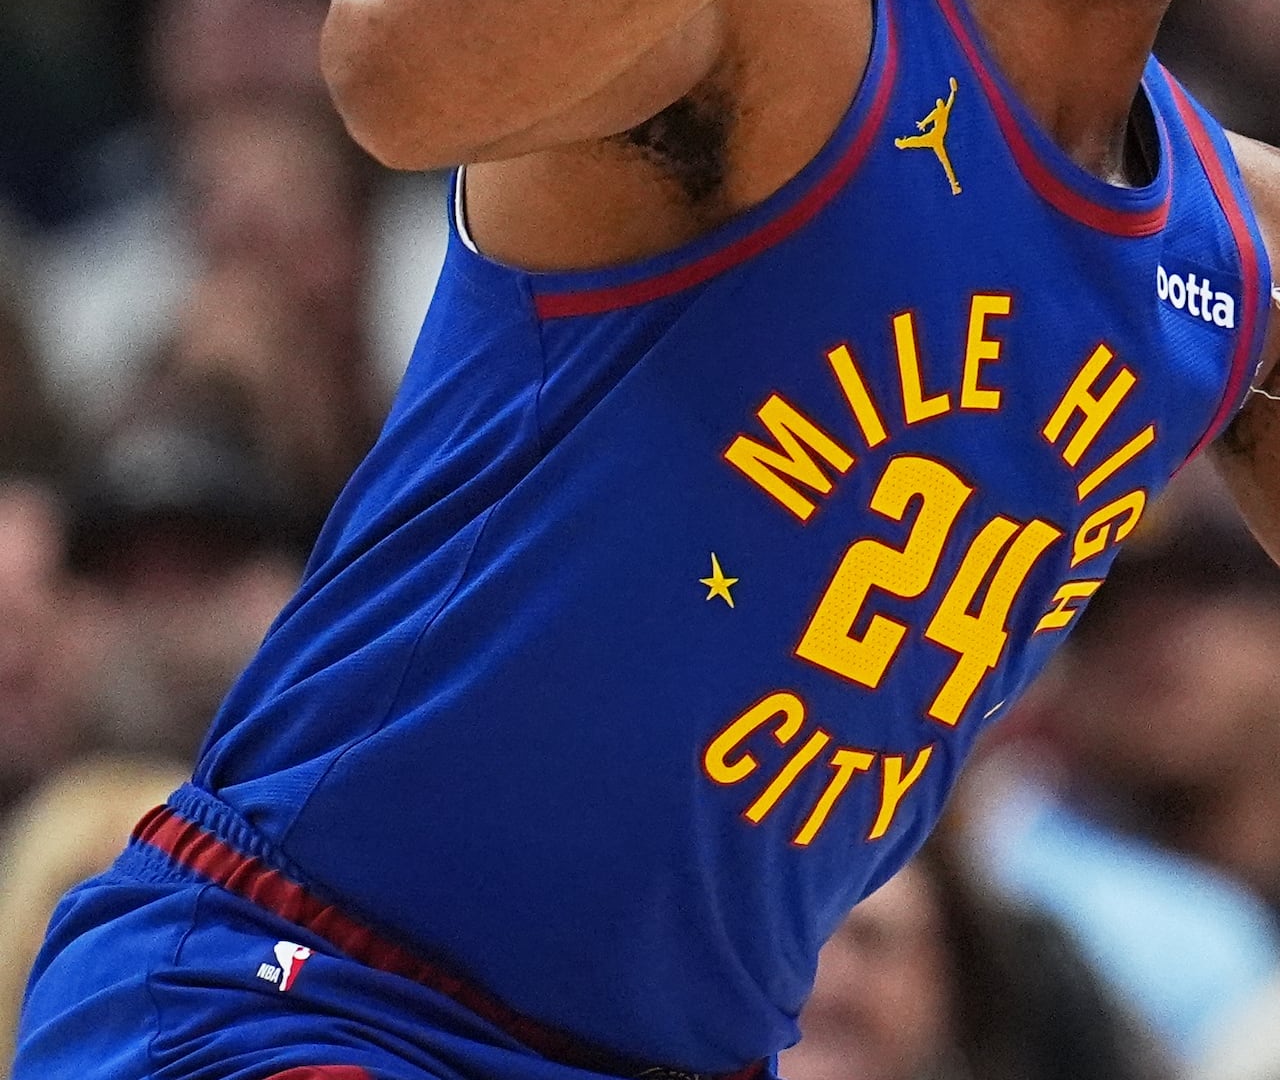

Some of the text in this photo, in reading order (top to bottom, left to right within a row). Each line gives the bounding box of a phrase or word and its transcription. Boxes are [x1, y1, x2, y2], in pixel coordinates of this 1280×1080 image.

[723, 293, 1156, 634] MILE HIGH
[794, 454, 1062, 727] 24
[702, 691, 934, 848] CITY
[257, 963, 281, 983] NBA
